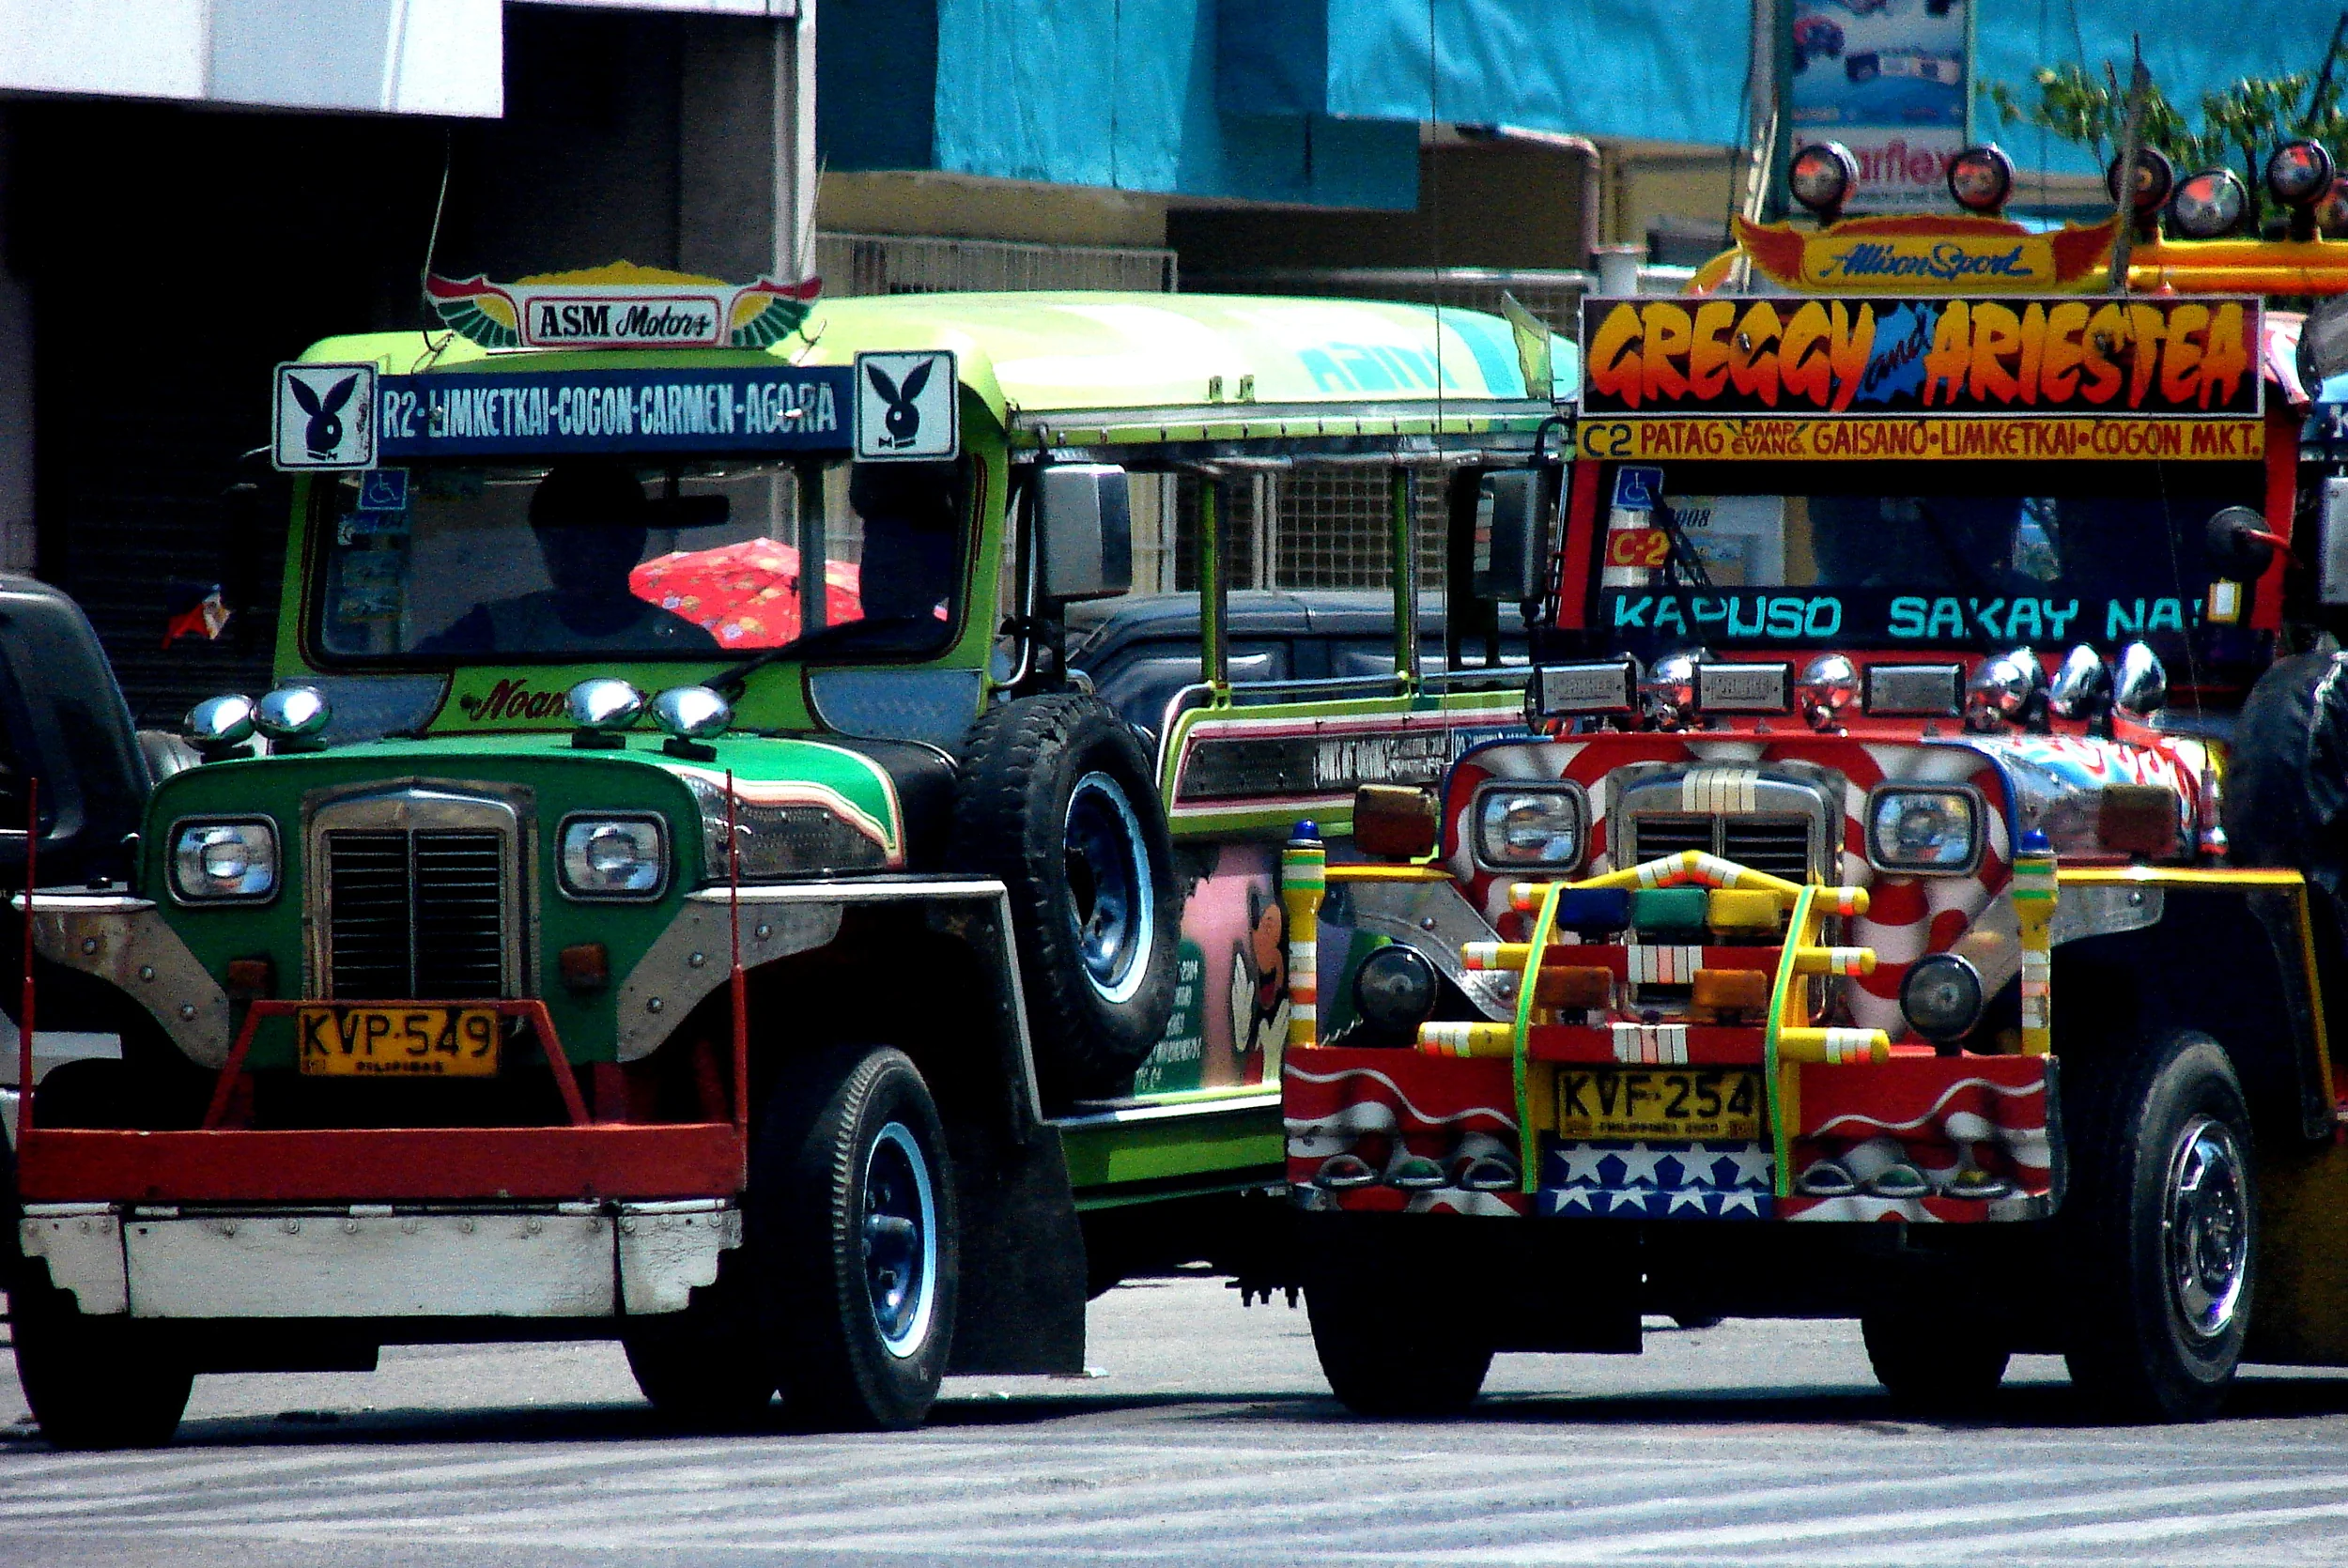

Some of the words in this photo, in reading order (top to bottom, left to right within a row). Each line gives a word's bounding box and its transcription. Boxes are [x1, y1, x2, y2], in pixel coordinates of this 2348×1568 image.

[538, 304, 610, 338] ASM
[615, 304, 711, 338] Motors
[1583, 424, 1632, 456] C2
[1642, 423, 1725, 454] PATAG
[1671, 508, 1711, 527] 008
[1613, 530, 1670, 566] C-2
